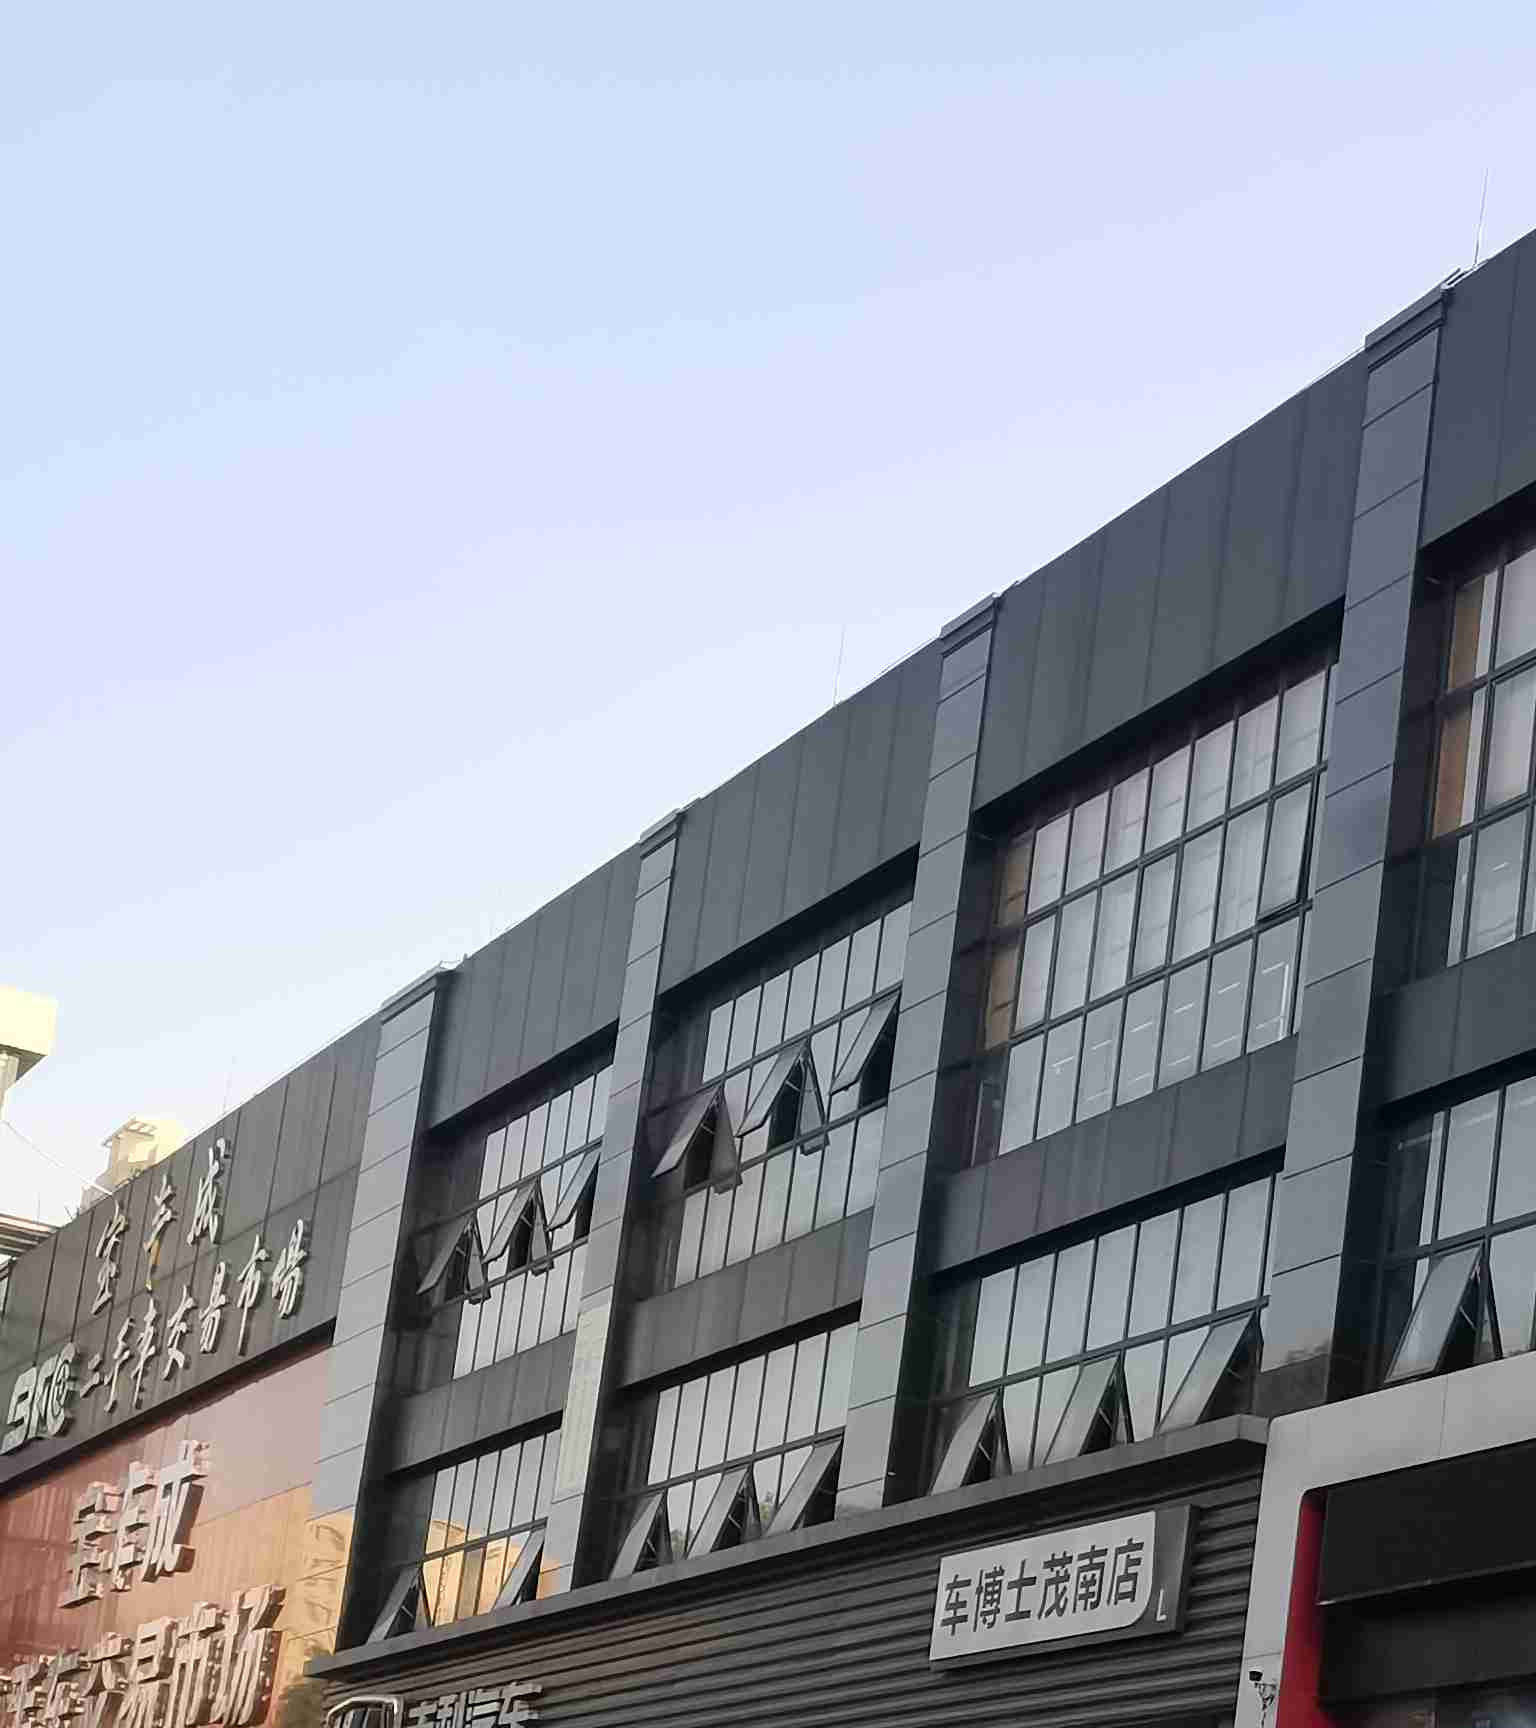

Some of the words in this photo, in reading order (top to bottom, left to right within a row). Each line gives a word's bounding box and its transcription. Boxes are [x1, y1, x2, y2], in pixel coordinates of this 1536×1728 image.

[940, 1538, 1145, 1637] 车博士茂南店
